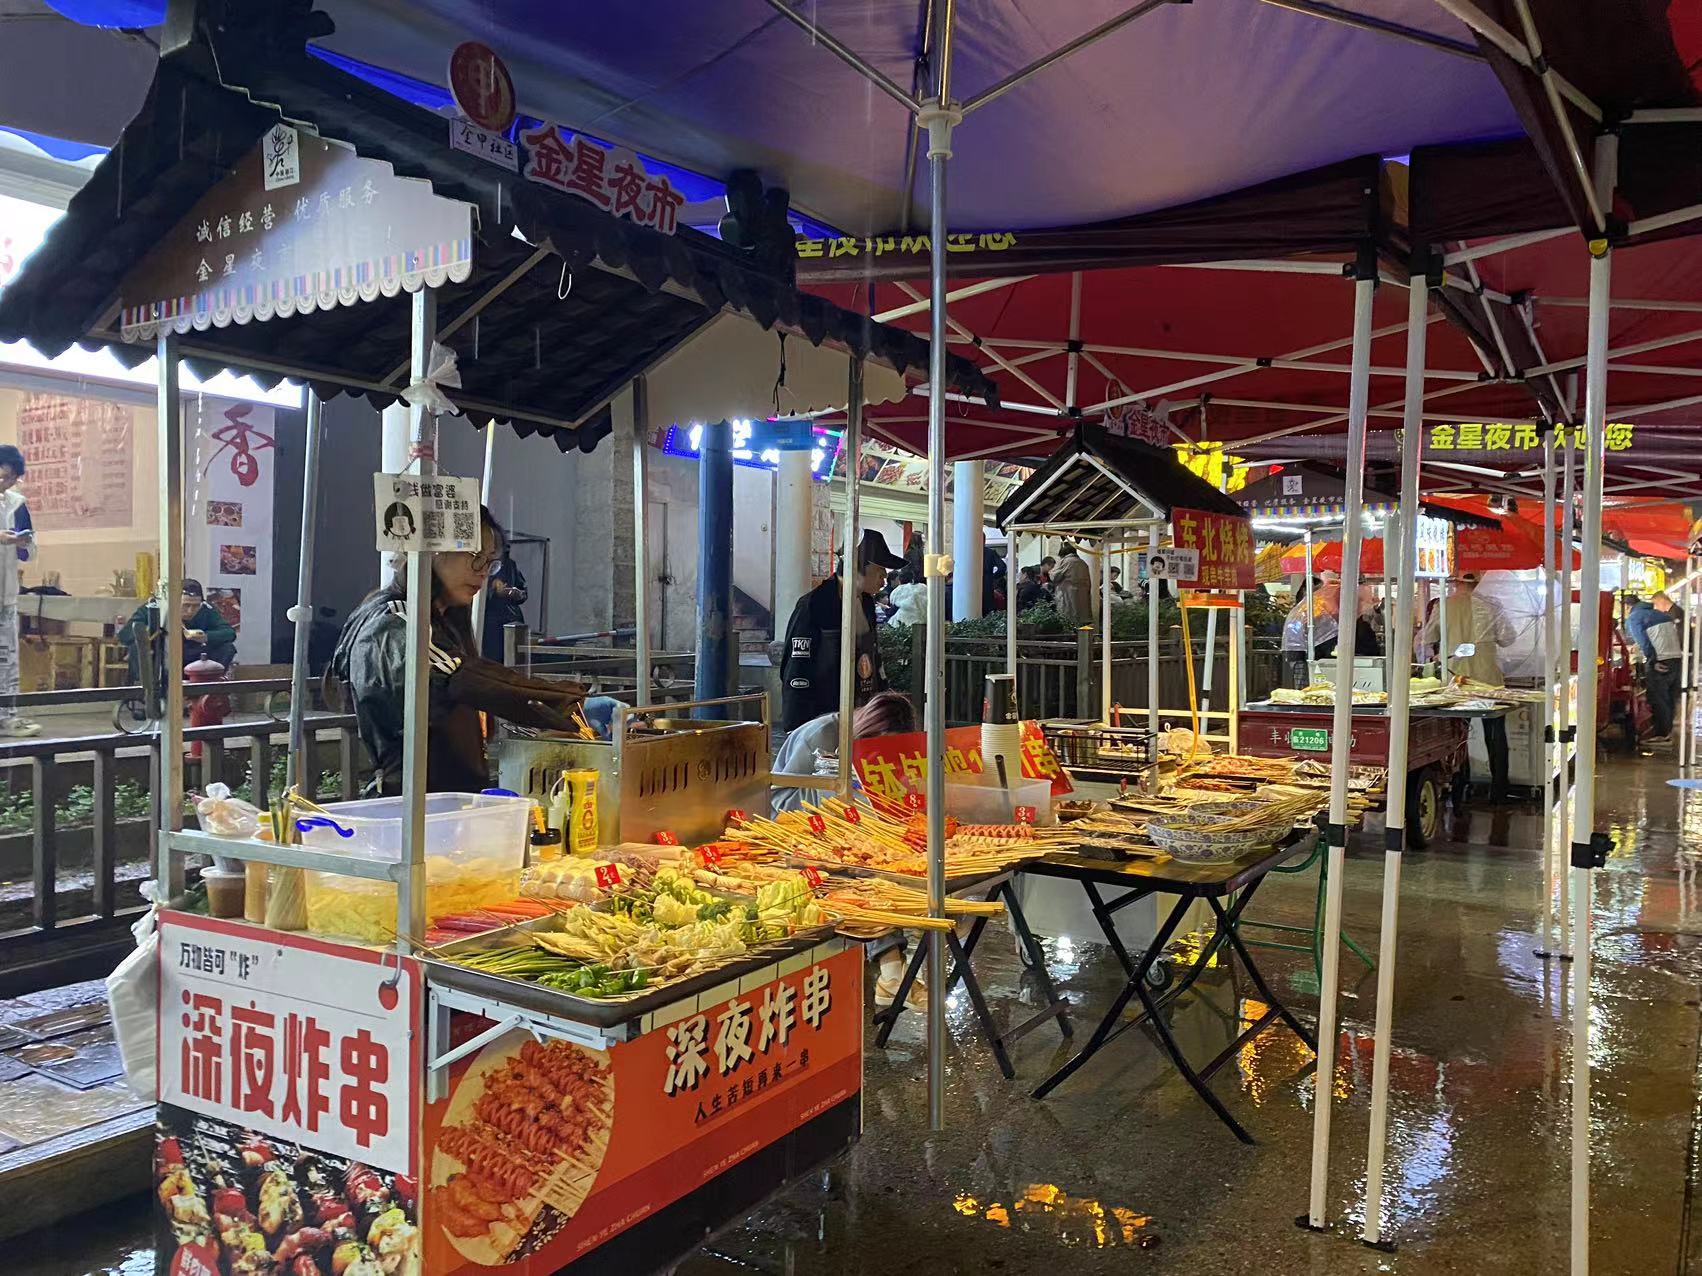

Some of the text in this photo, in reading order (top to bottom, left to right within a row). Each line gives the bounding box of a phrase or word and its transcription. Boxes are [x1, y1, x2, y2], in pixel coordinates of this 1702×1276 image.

[196, 179, 380, 243] 诚信经营 优质服务
[526, 125, 685, 233] 金星夜市
[1180, 513, 1249, 564] 东北烧烤
[181, 989, 389, 1149] 深夜炸串
[664, 965, 830, 1096] 深夜炸串
[694, 1048, 810, 1123] 人生苦短再来一串
